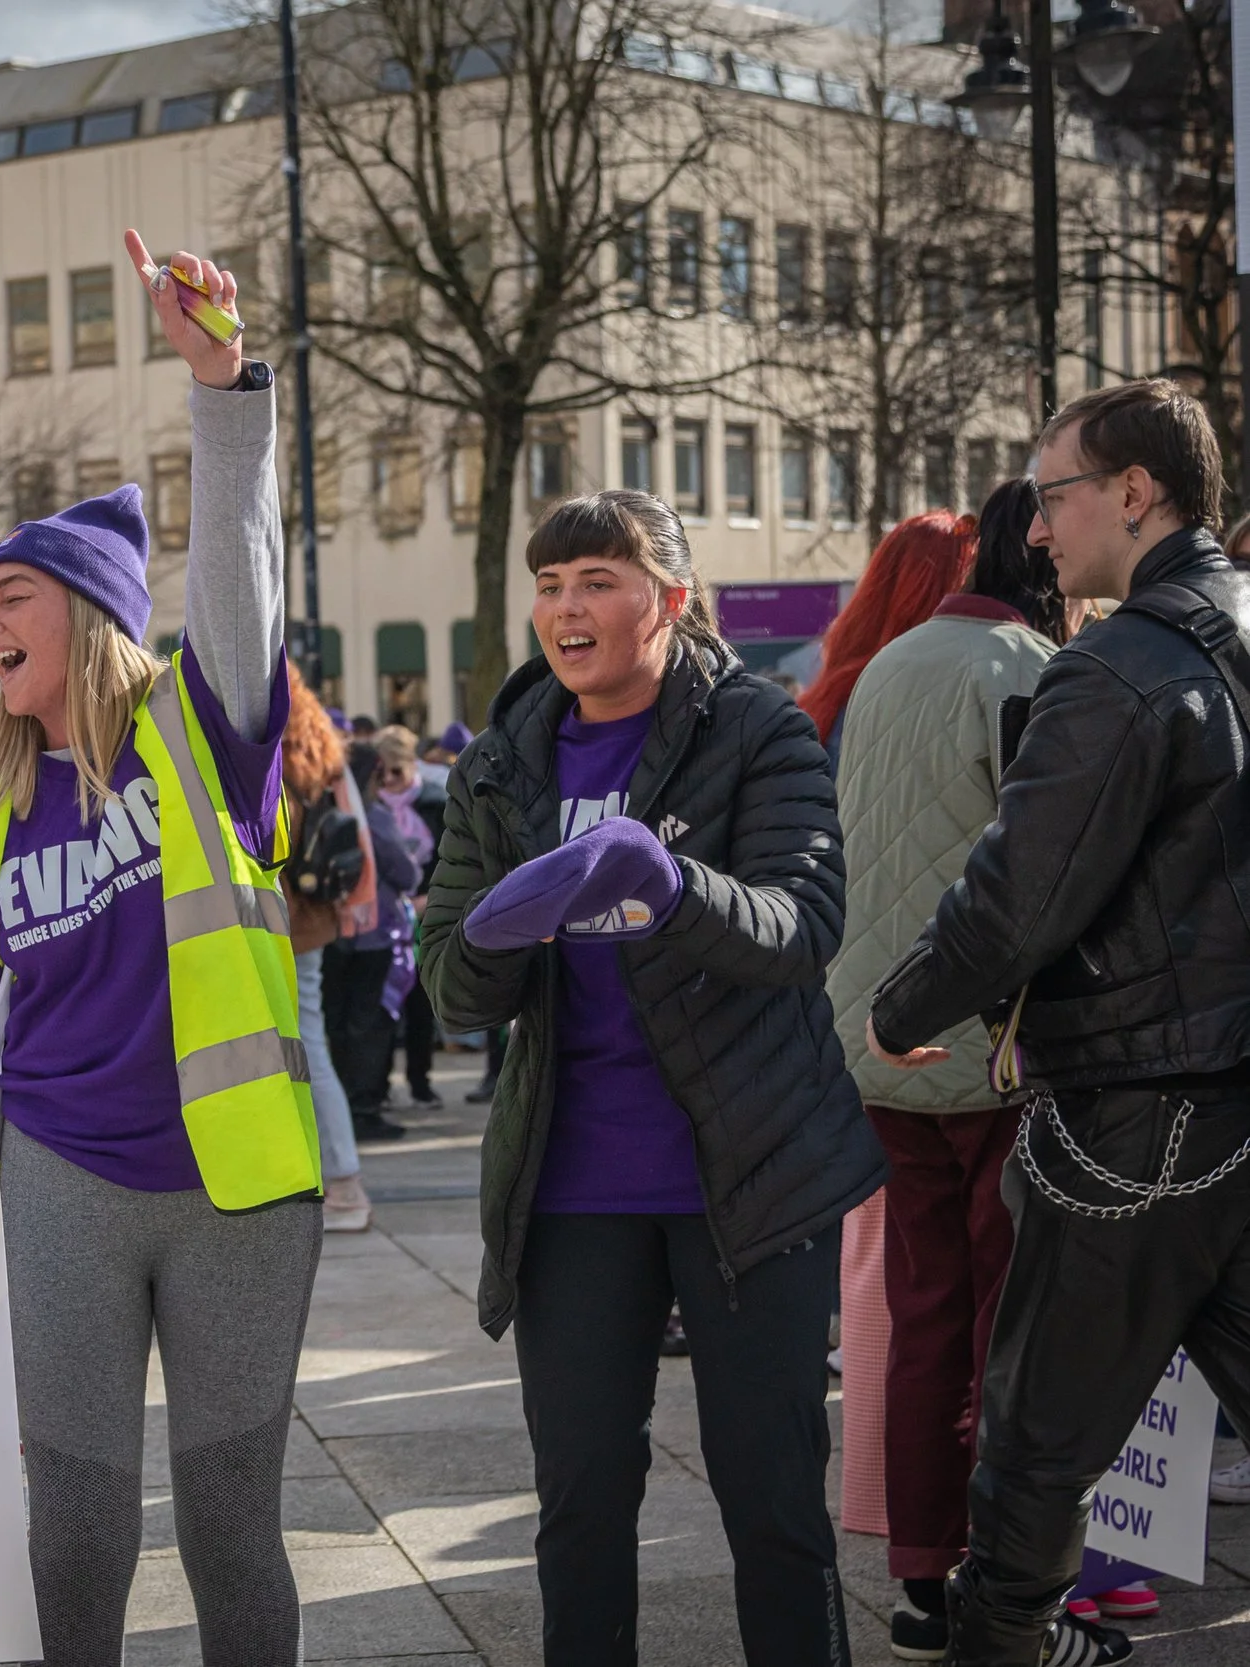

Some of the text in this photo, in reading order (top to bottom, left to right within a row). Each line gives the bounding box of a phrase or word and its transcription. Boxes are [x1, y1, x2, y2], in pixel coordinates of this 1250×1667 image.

[7, 924, 50, 953] SILENCE
[112, 869, 139, 893] THE
[135, 857, 162, 881] VIO
[1092, 1491, 1153, 1539] NOW
